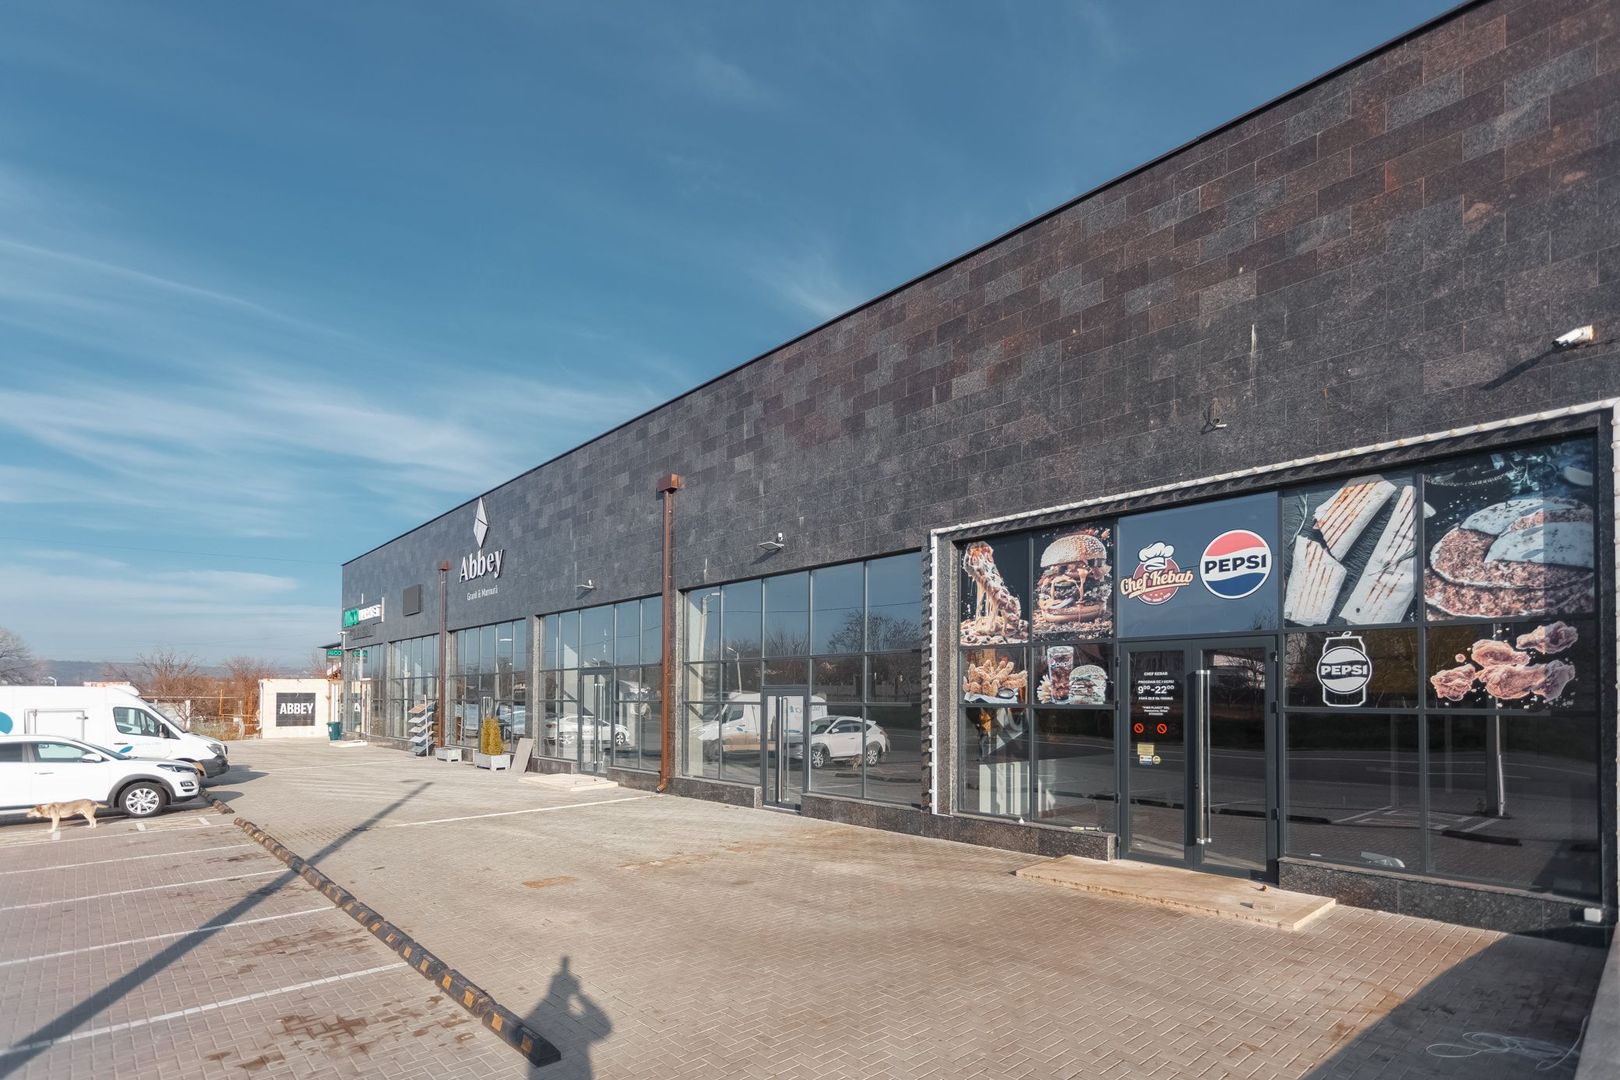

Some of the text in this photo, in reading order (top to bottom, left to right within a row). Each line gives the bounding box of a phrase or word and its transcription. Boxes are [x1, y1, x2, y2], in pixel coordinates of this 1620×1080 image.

[459, 549, 504, 583] Abbey
[1204, 554, 1267, 574] PEPSI
[1120, 569, 1194, 596] Chef Kebab
[1320, 664, 1368, 675] PEPSI
[279, 702, 314, 715] ABBEY
